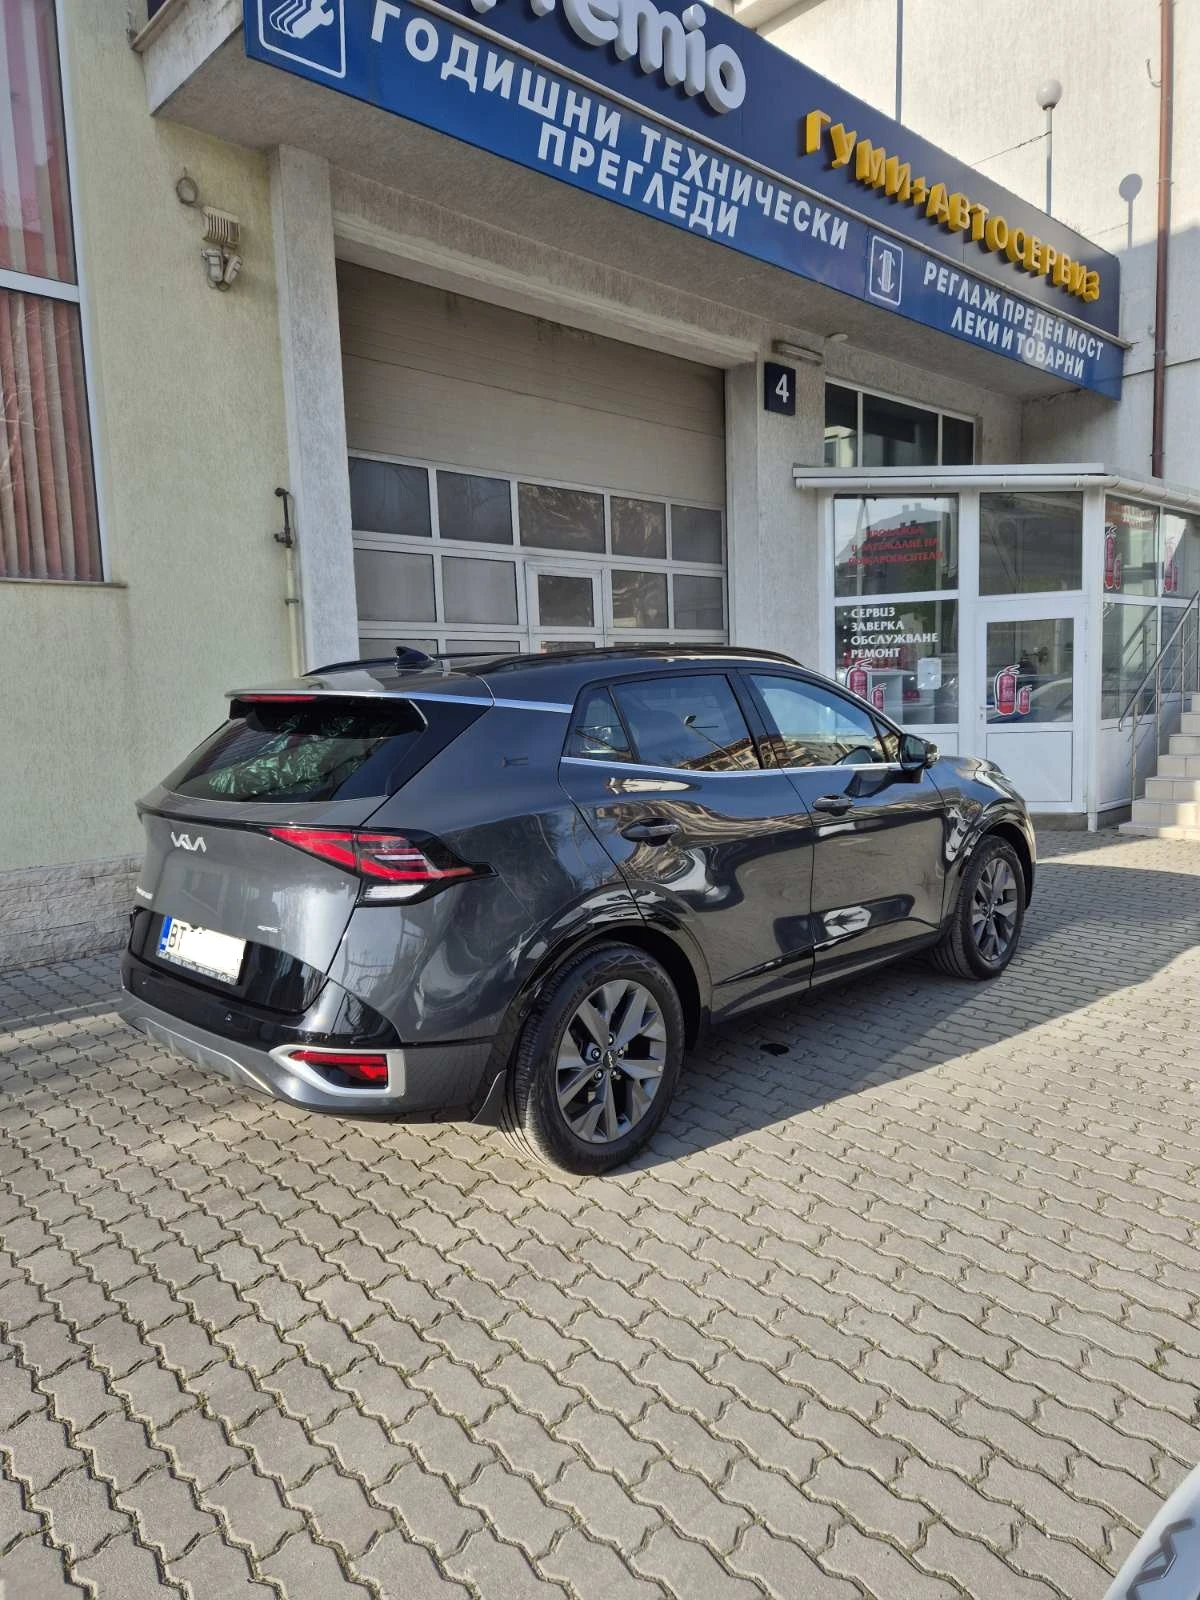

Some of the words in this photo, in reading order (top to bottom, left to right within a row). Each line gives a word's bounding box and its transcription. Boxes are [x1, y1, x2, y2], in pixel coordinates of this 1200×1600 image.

[470, 0, 747, 114] emio
[370, 0, 622, 148] ГОДИШНИ
[640, 125, 849, 250] ТЕХНИЧЕСКИ
[537, 122, 740, 238] ПРЕГЛЕДИ
[923, 261, 1001, 316] РЕГЛАЖ
[1002, 298, 1064, 344] ПРЕДЕН
[1065, 327, 1104, 361] МОСТ
[951, 306, 1000, 345] ЛЕКИ
[1001, 326, 1014, 350] И
[1015, 332, 1085, 379] ТОВАРНИ
[775, 373, 790, 403] 4
[850, 632, 939, 646] ОБСЛУЖВАНЕ
[851, 620, 904, 632] ЗАВЕРКА
[851, 647, 901, 659] РЕМОНТ
